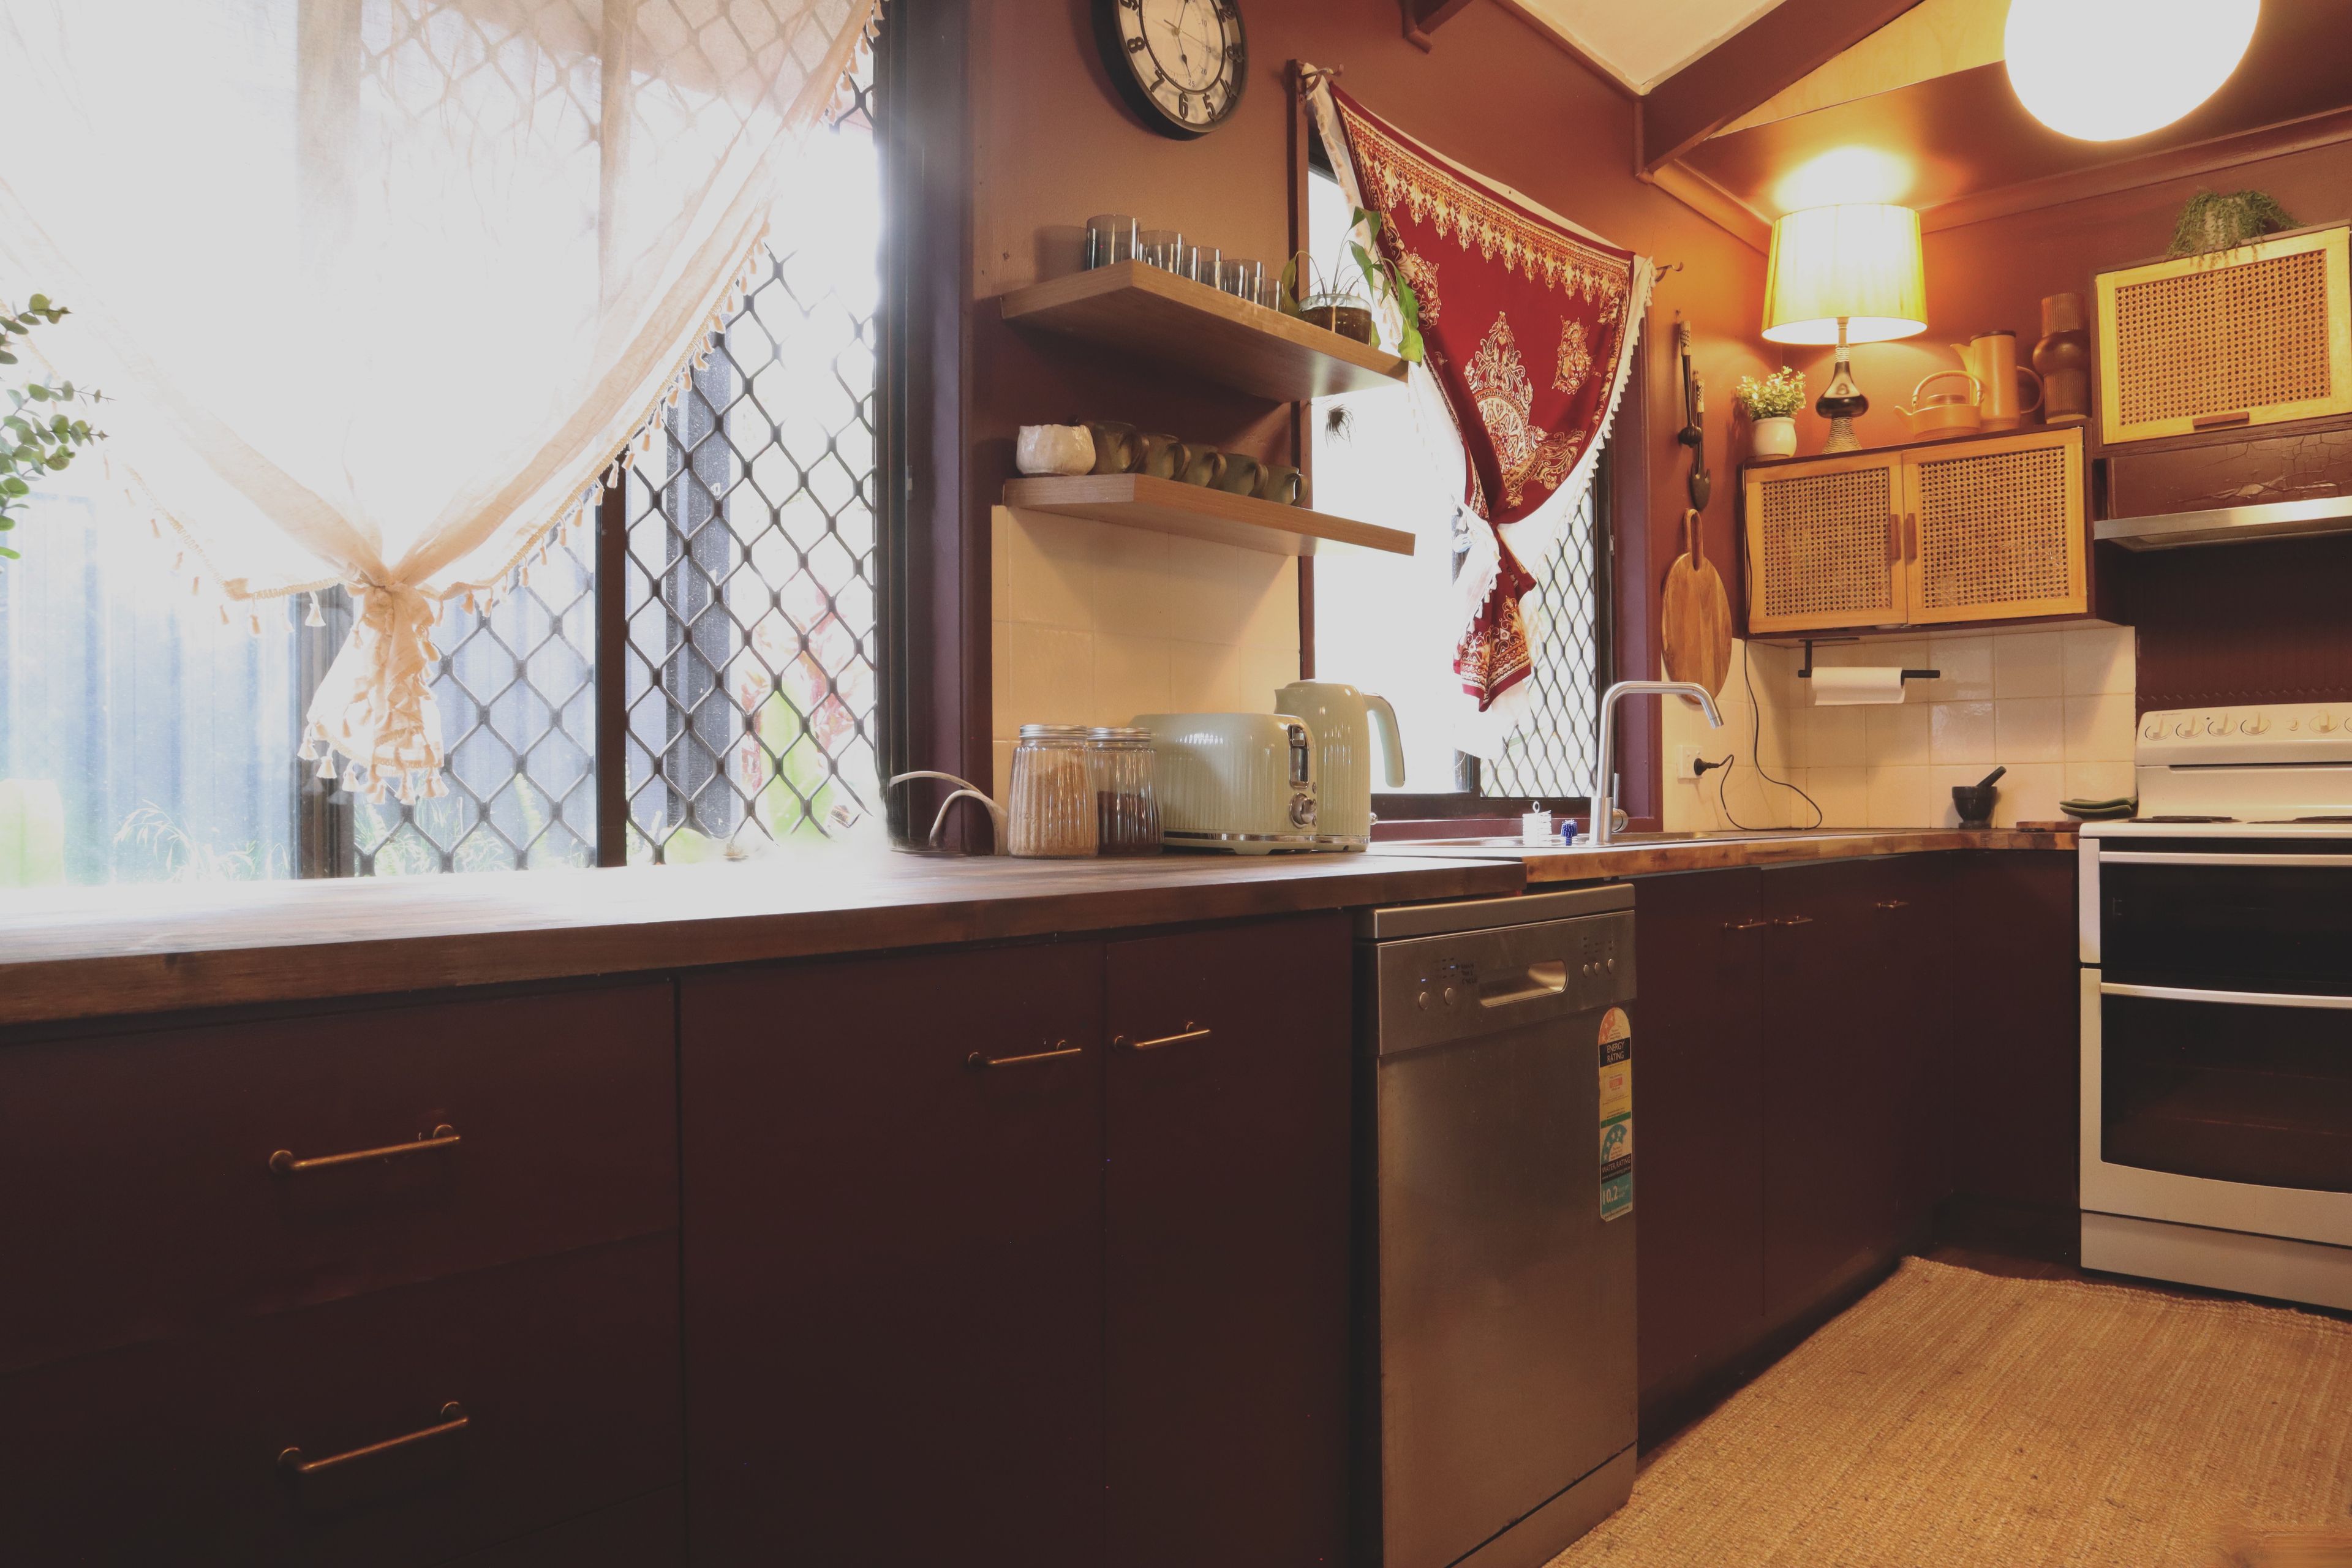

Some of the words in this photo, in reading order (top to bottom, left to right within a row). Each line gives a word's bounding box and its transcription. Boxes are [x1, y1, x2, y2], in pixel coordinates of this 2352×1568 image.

[1201, 19, 1208, 28] 10
[1126, 36, 1146, 54] 8
[1200, 67, 1208, 76] 20
[1150, 70, 1166, 92] 7
[1188, 78, 1196, 88] 25
[1219, 78, 1238, 99] 4
[1178, 92, 1189, 121] 6
[1202, 93, 1216, 124] 5
[1607, 1040, 1625, 1054] ENERGY
[1607, 1051, 1624, 1063] RATING
[1601, 1163, 1616, 1173] WATER
[1616, 1156, 1631, 1167] RATING
